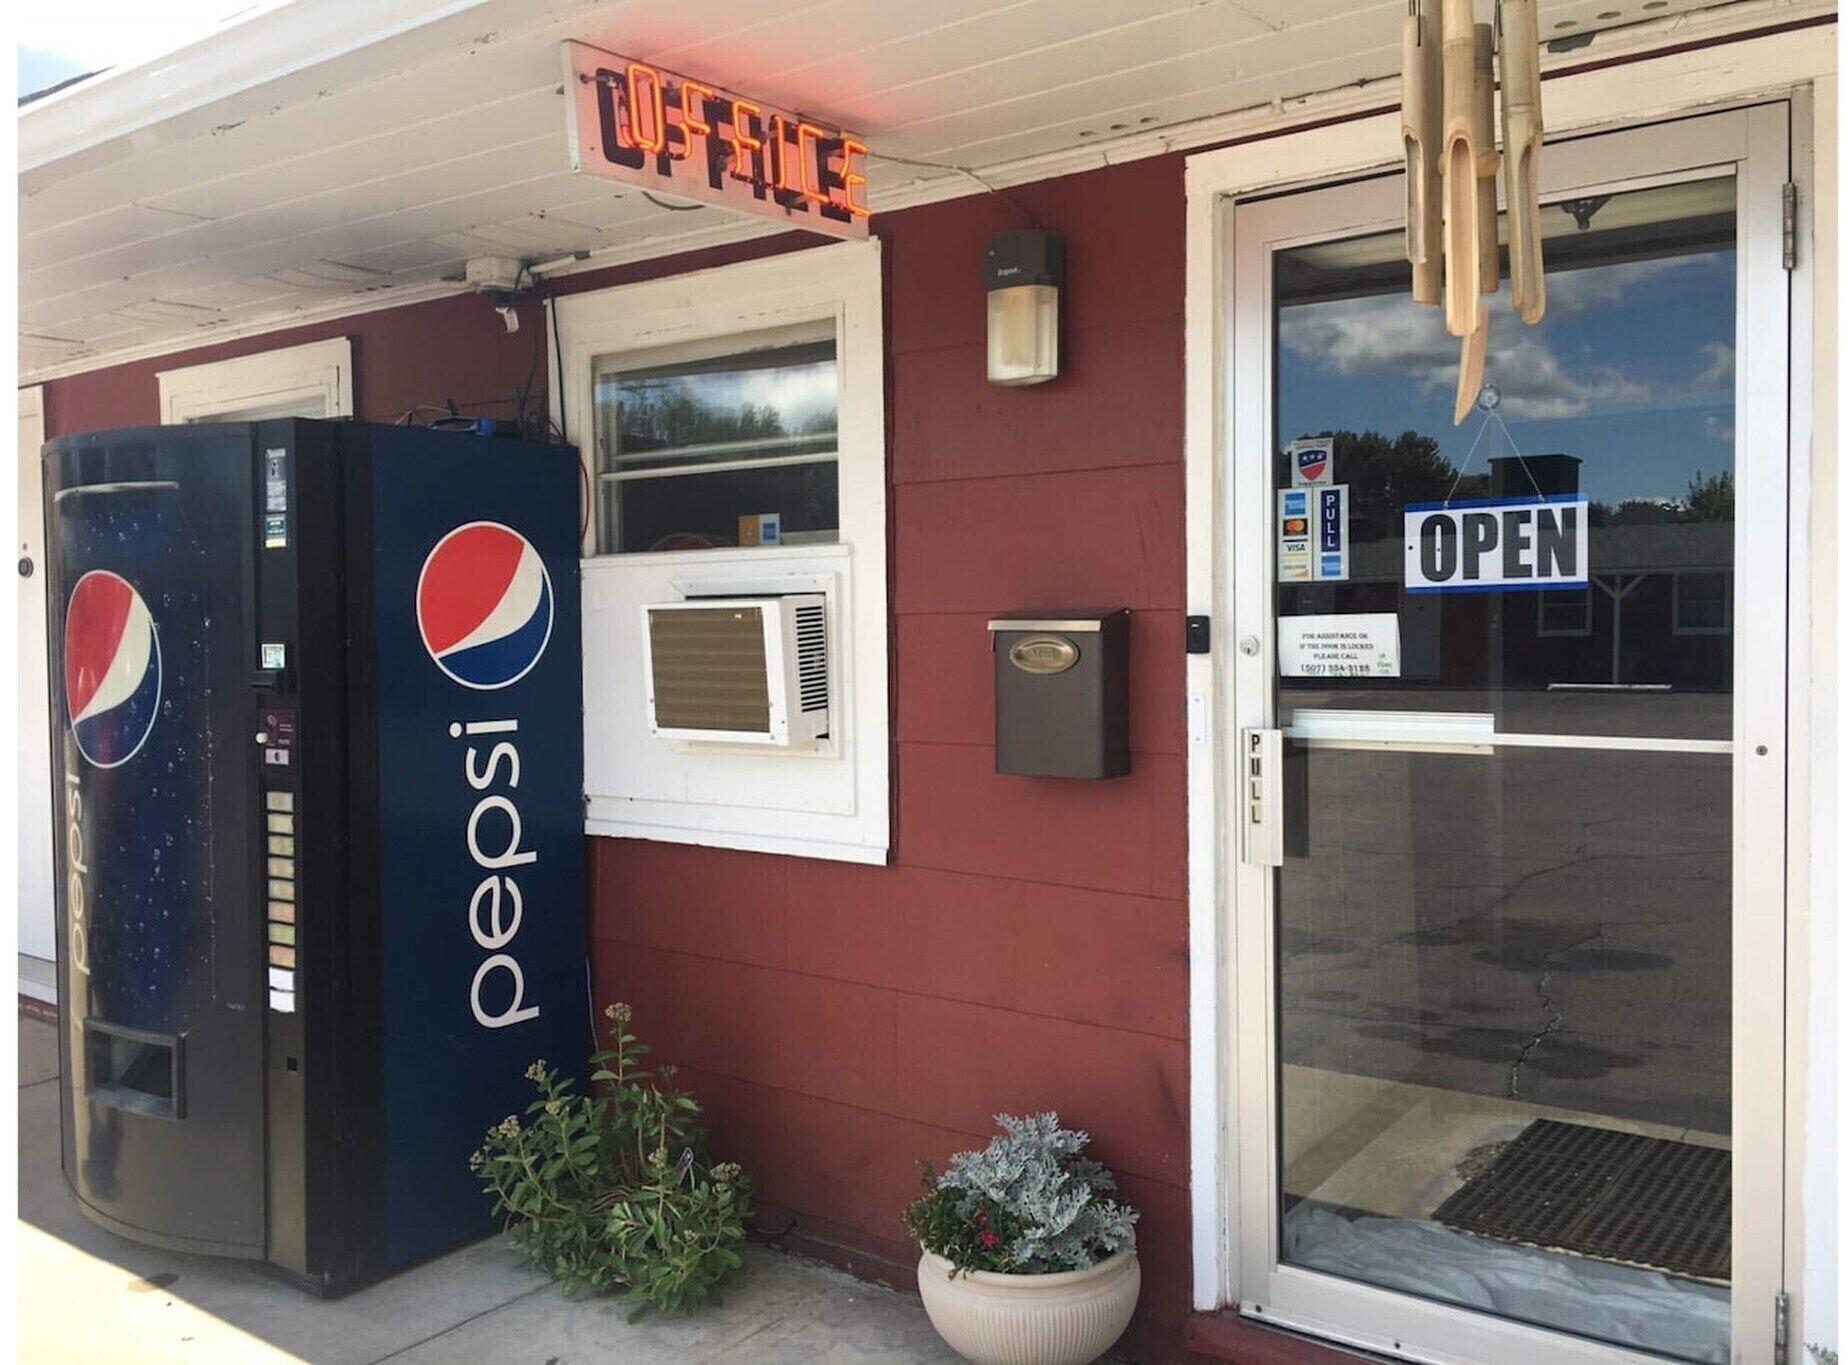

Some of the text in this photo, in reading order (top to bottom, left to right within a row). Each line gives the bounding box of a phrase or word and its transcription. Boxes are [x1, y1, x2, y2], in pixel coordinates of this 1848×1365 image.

[597, 63, 871, 223] OFFICE
[1286, 544, 1306, 552] VISA
[1325, 494, 1336, 548] PULL
[1420, 507, 1578, 582] OPEN
[1251, 734, 1261, 824] PULL
[65, 771, 91, 976] pepsi
[449, 719, 540, 1028] pepsi
